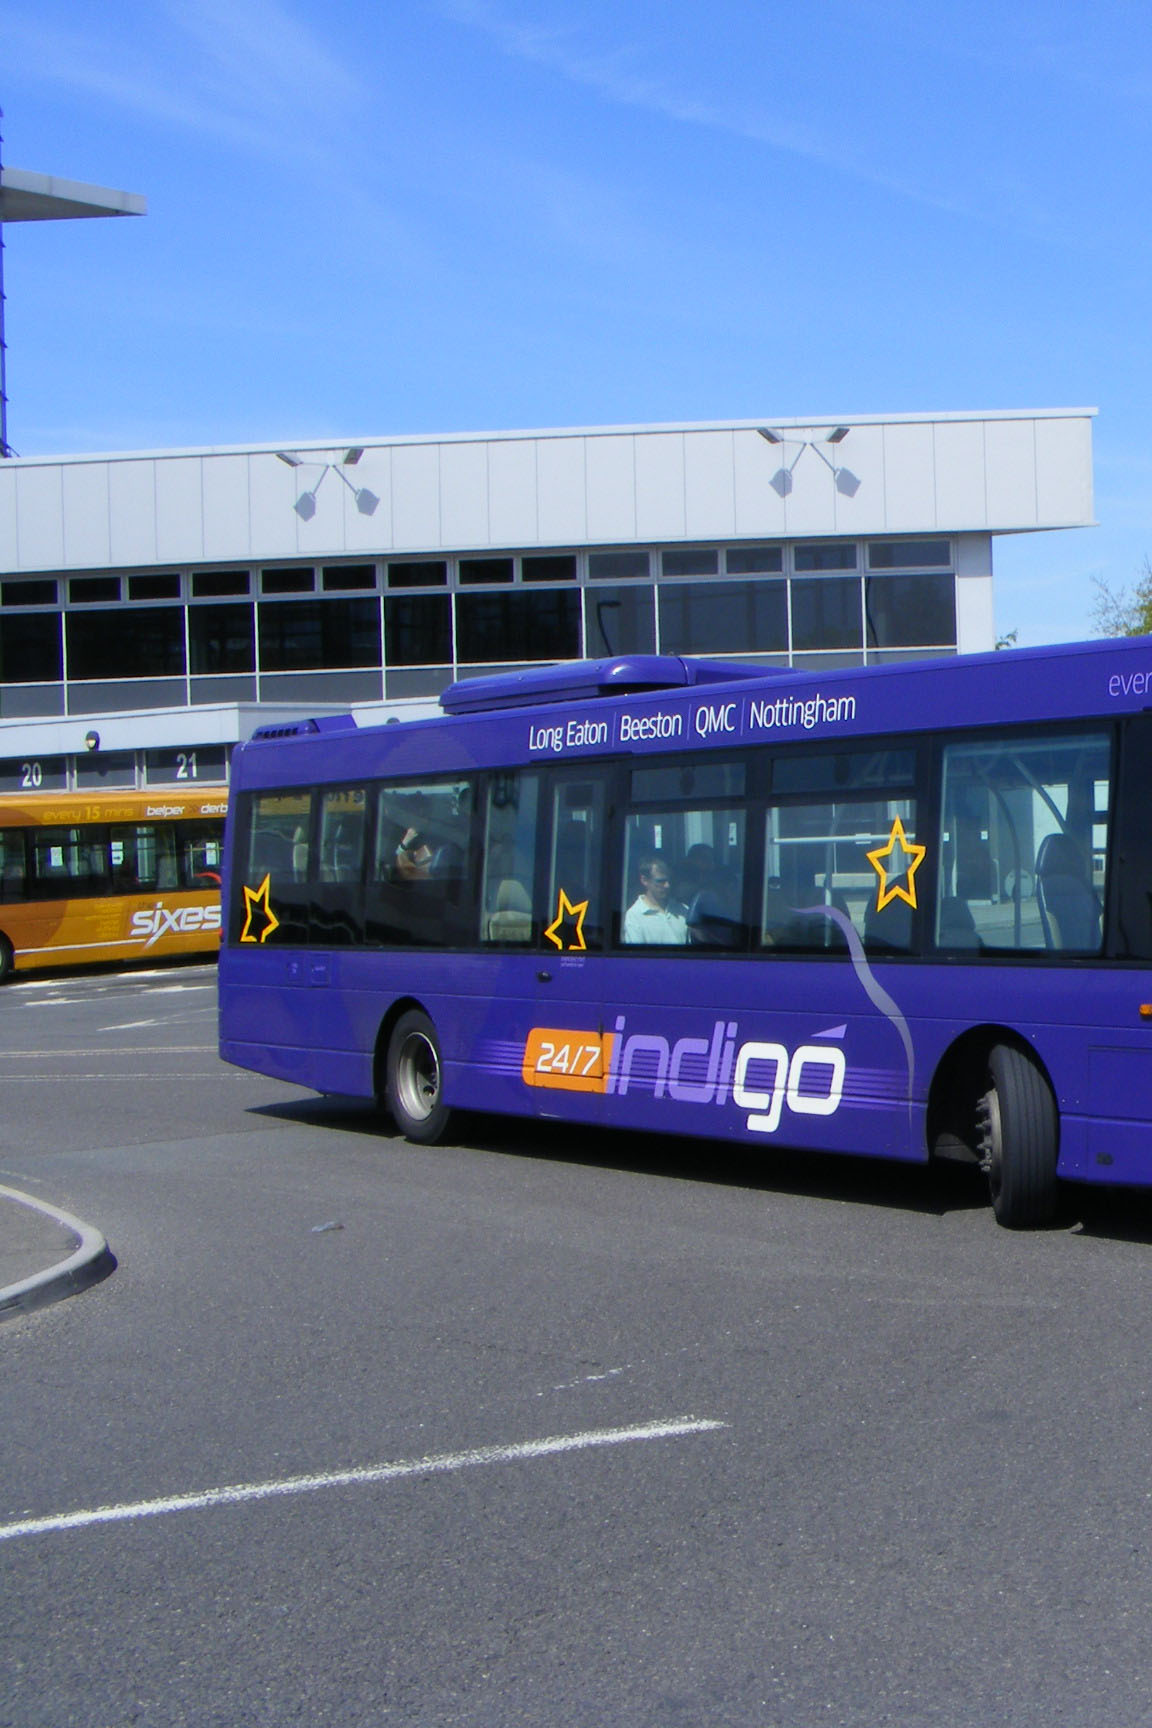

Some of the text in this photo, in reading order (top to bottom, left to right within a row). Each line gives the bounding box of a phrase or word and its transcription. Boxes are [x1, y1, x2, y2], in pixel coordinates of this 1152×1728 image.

[528, 694, 856, 752] Long Eaton Beeston QMC Nottingham
[22, 762, 42, 787] 20
[176, 752, 197, 779] 21
[43, 805, 134, 821] every 15 mins
[146, 804, 186, 817] belper
[200, 803, 229, 814] derb
[130, 901, 222, 949] sixes
[535, 1015, 847, 1133] 24/7 indigo
